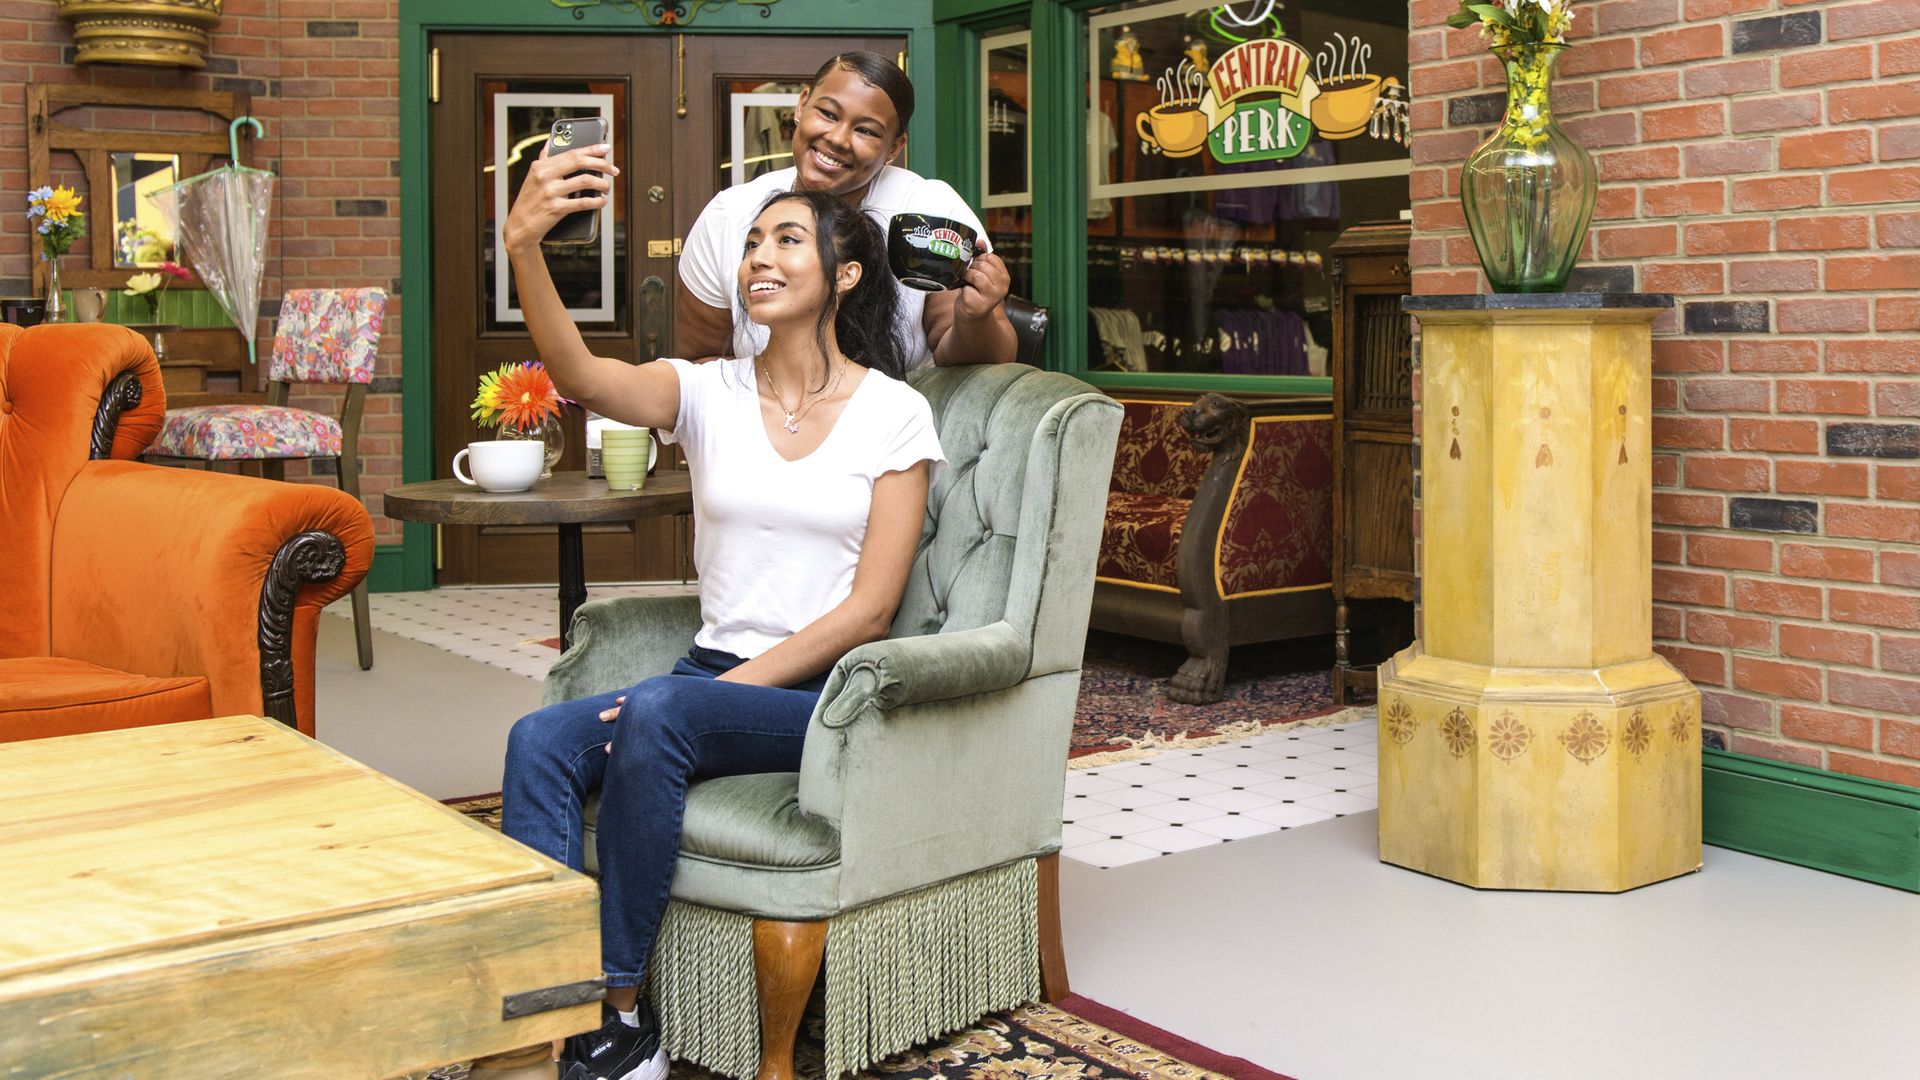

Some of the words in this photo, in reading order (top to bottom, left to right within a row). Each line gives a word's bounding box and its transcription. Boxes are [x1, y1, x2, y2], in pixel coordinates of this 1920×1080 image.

[1213, 41, 1301, 102] CENTRAL
[1223, 107, 1297, 154] PERK
[934, 229, 961, 245] CENTRAL
[934, 240, 958, 257] PERK
